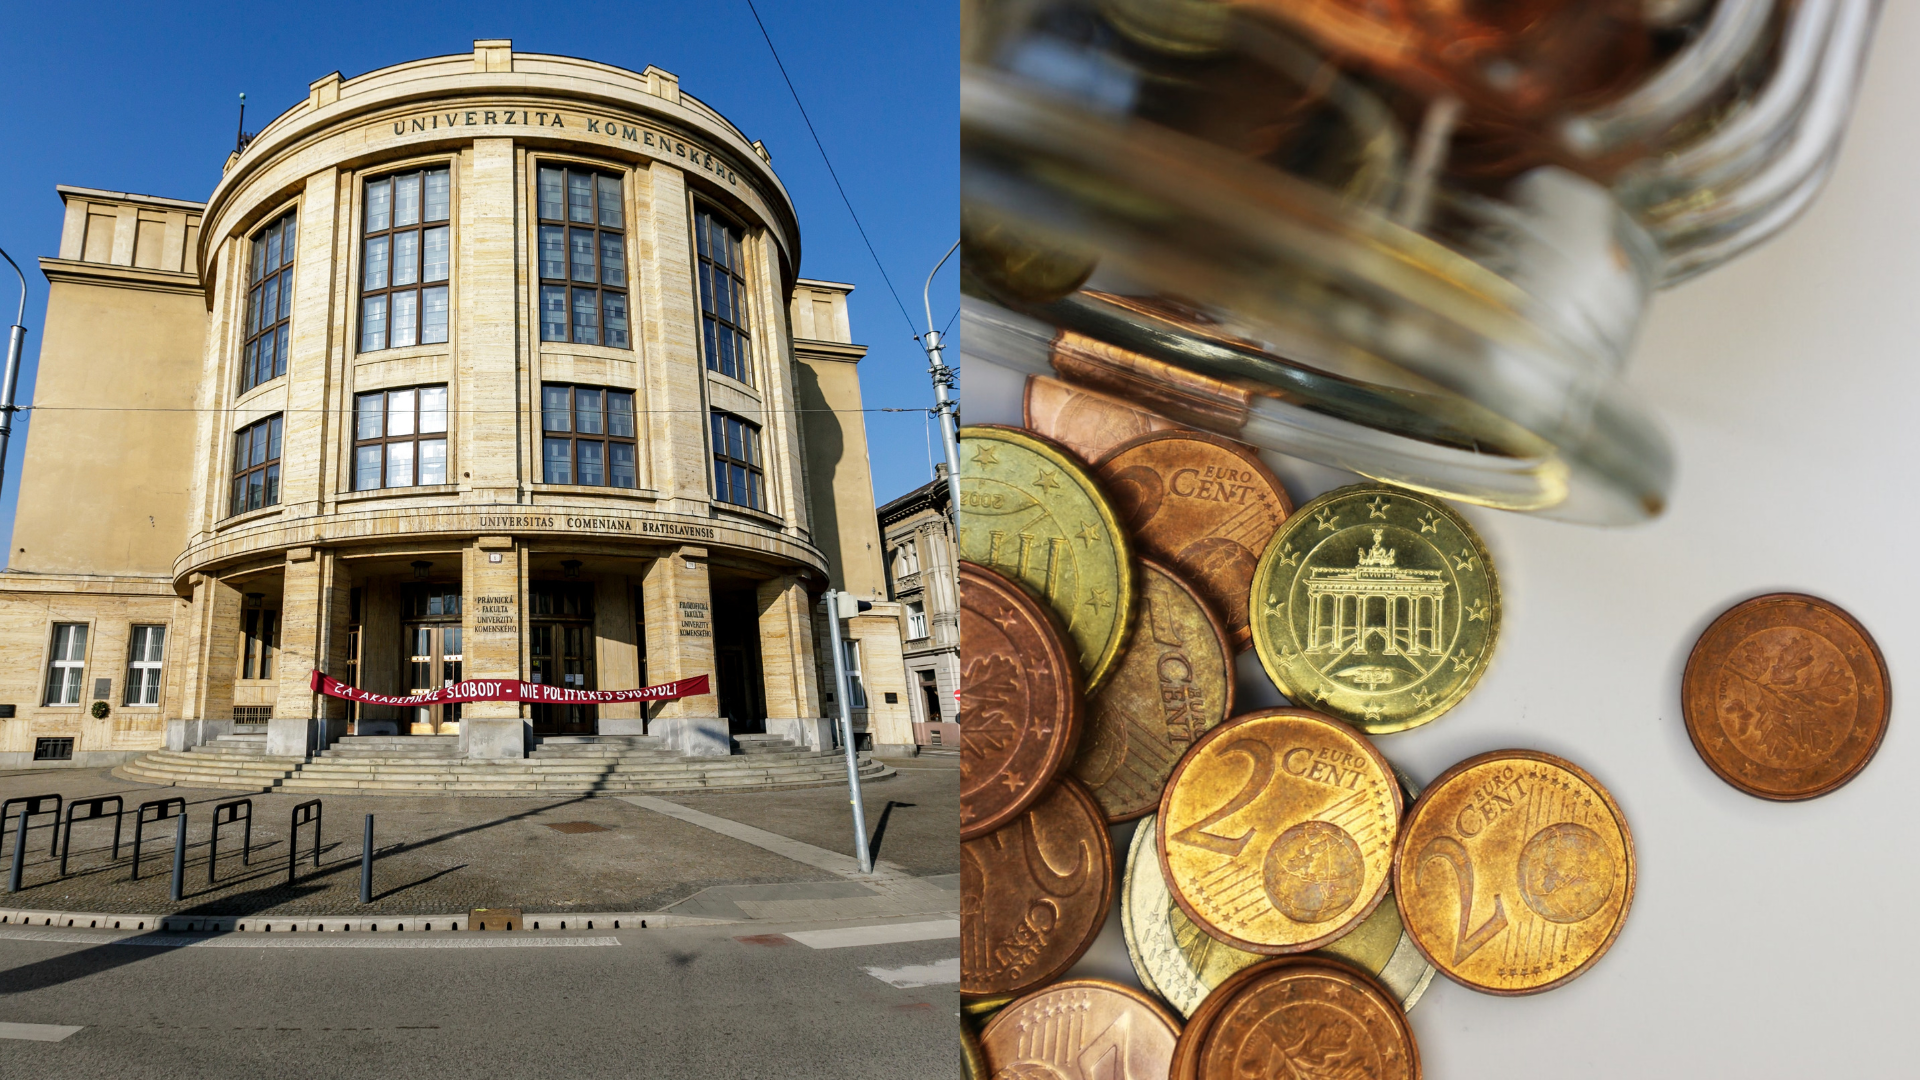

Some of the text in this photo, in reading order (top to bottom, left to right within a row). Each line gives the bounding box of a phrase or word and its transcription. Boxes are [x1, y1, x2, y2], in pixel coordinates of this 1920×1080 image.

[394, 110, 737, 186] UNIVERZITA KOMENSKÉHO
[1204, 465, 1252, 483] EURO
[1169, 468, 1256, 505] CENT
[480, 516, 715, 539] UNIVERSITAS COMENIANA BRATISLAVENSIS
[477, 595, 514, 604] PRÁVNICKÁ
[482, 605, 509, 613] FAKULTA
[477, 616, 513, 624] UNIVERZITY
[682, 621, 709, 629] UNIVERZITY
[684, 610, 704, 619] FAKULTA
[474, 624, 517, 633] KOMENSKÉHO
[334, 682, 353, 697] ZA
[446, 682, 502, 698] SLOBODY
[520, 683, 539, 699] NIE
[1156, 652, 1195, 746] CENT
[1282, 747, 1367, 791] CENT
[1318, 747, 1366, 769] EURO
[1474, 767, 1513, 802] EURO
[1170, 738, 1275, 857] 2
[1456, 773, 1528, 838] CENT
[1415, 835, 1509, 966] 2
